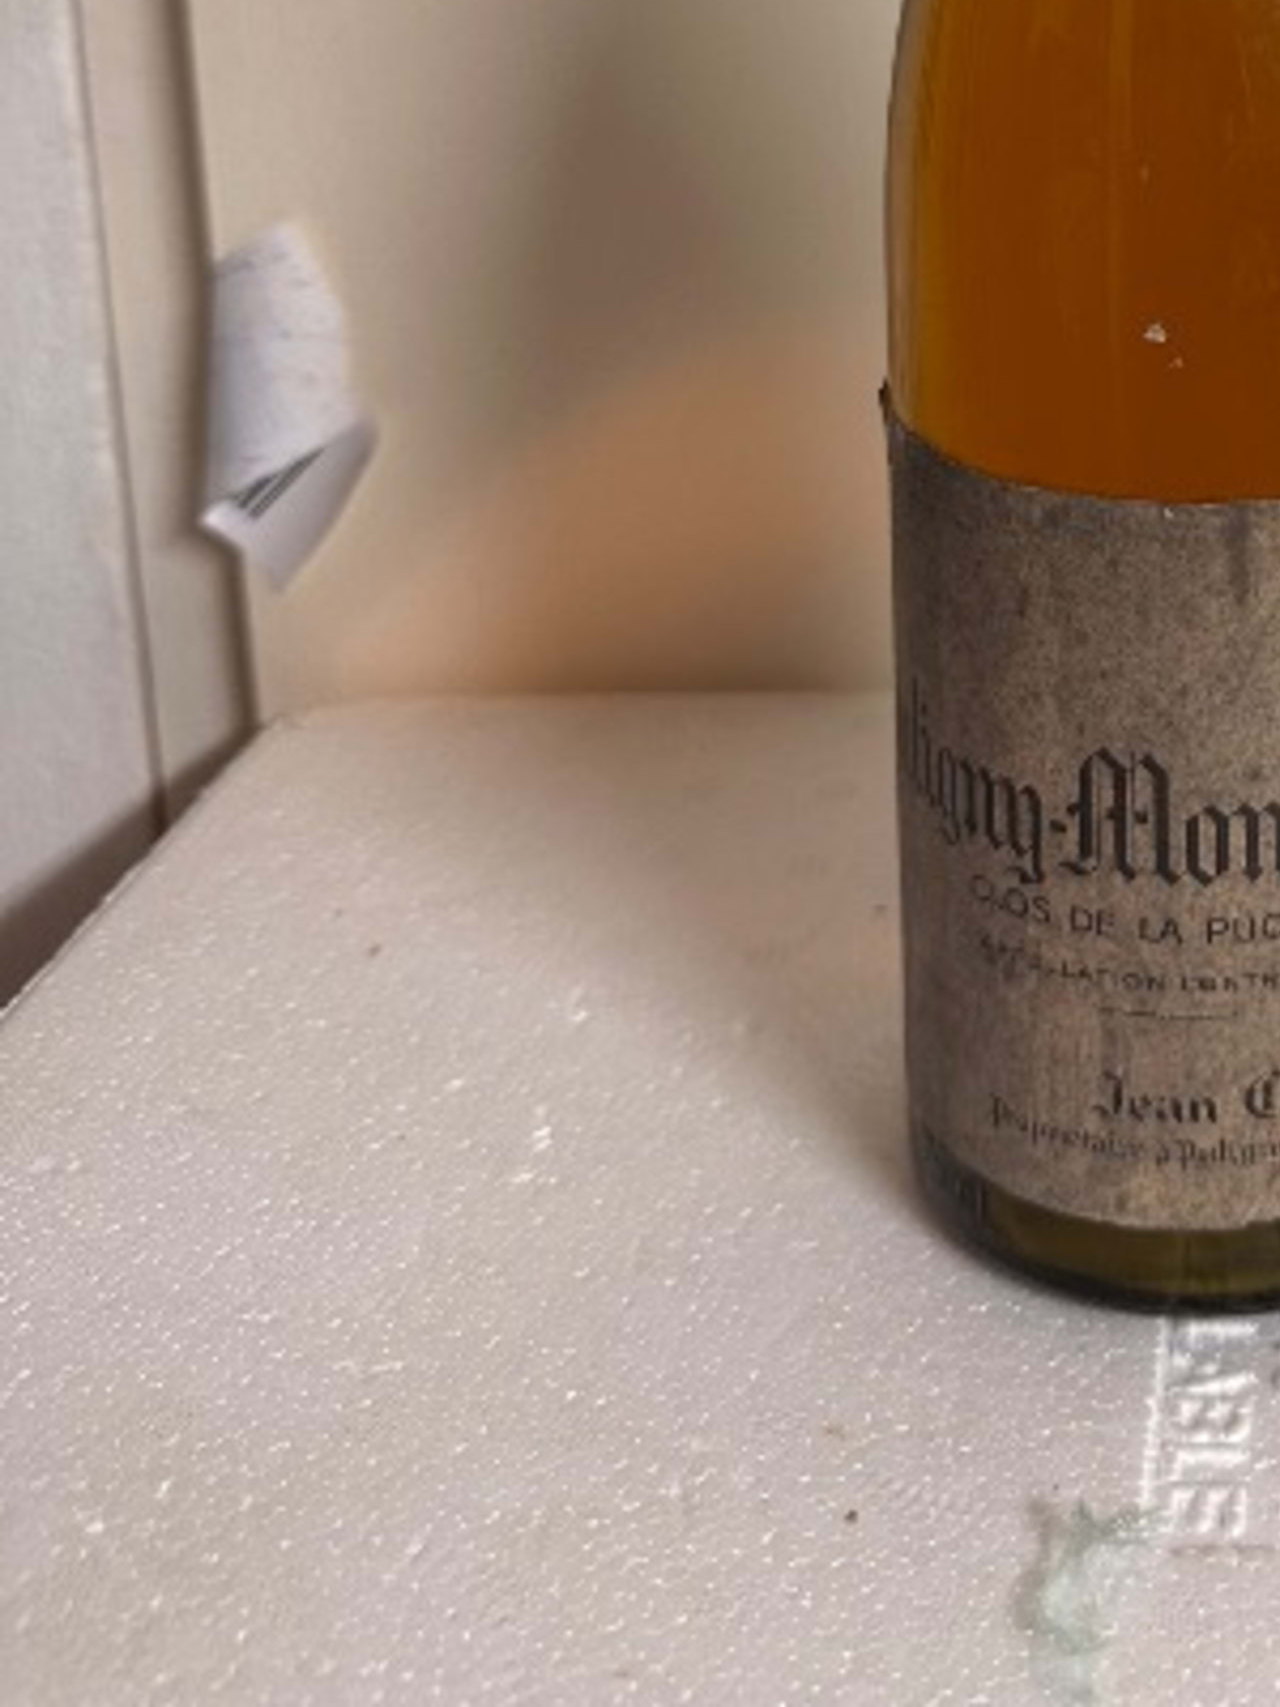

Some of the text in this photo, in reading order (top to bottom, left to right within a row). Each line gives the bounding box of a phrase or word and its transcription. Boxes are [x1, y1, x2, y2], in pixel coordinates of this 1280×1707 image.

[970, 874, 1050, 924] CLOS
[1070, 905, 1115, 935] DE
[1138, 915, 1183, 947] LA
[1092, 1070, 1218, 1124] Jean
